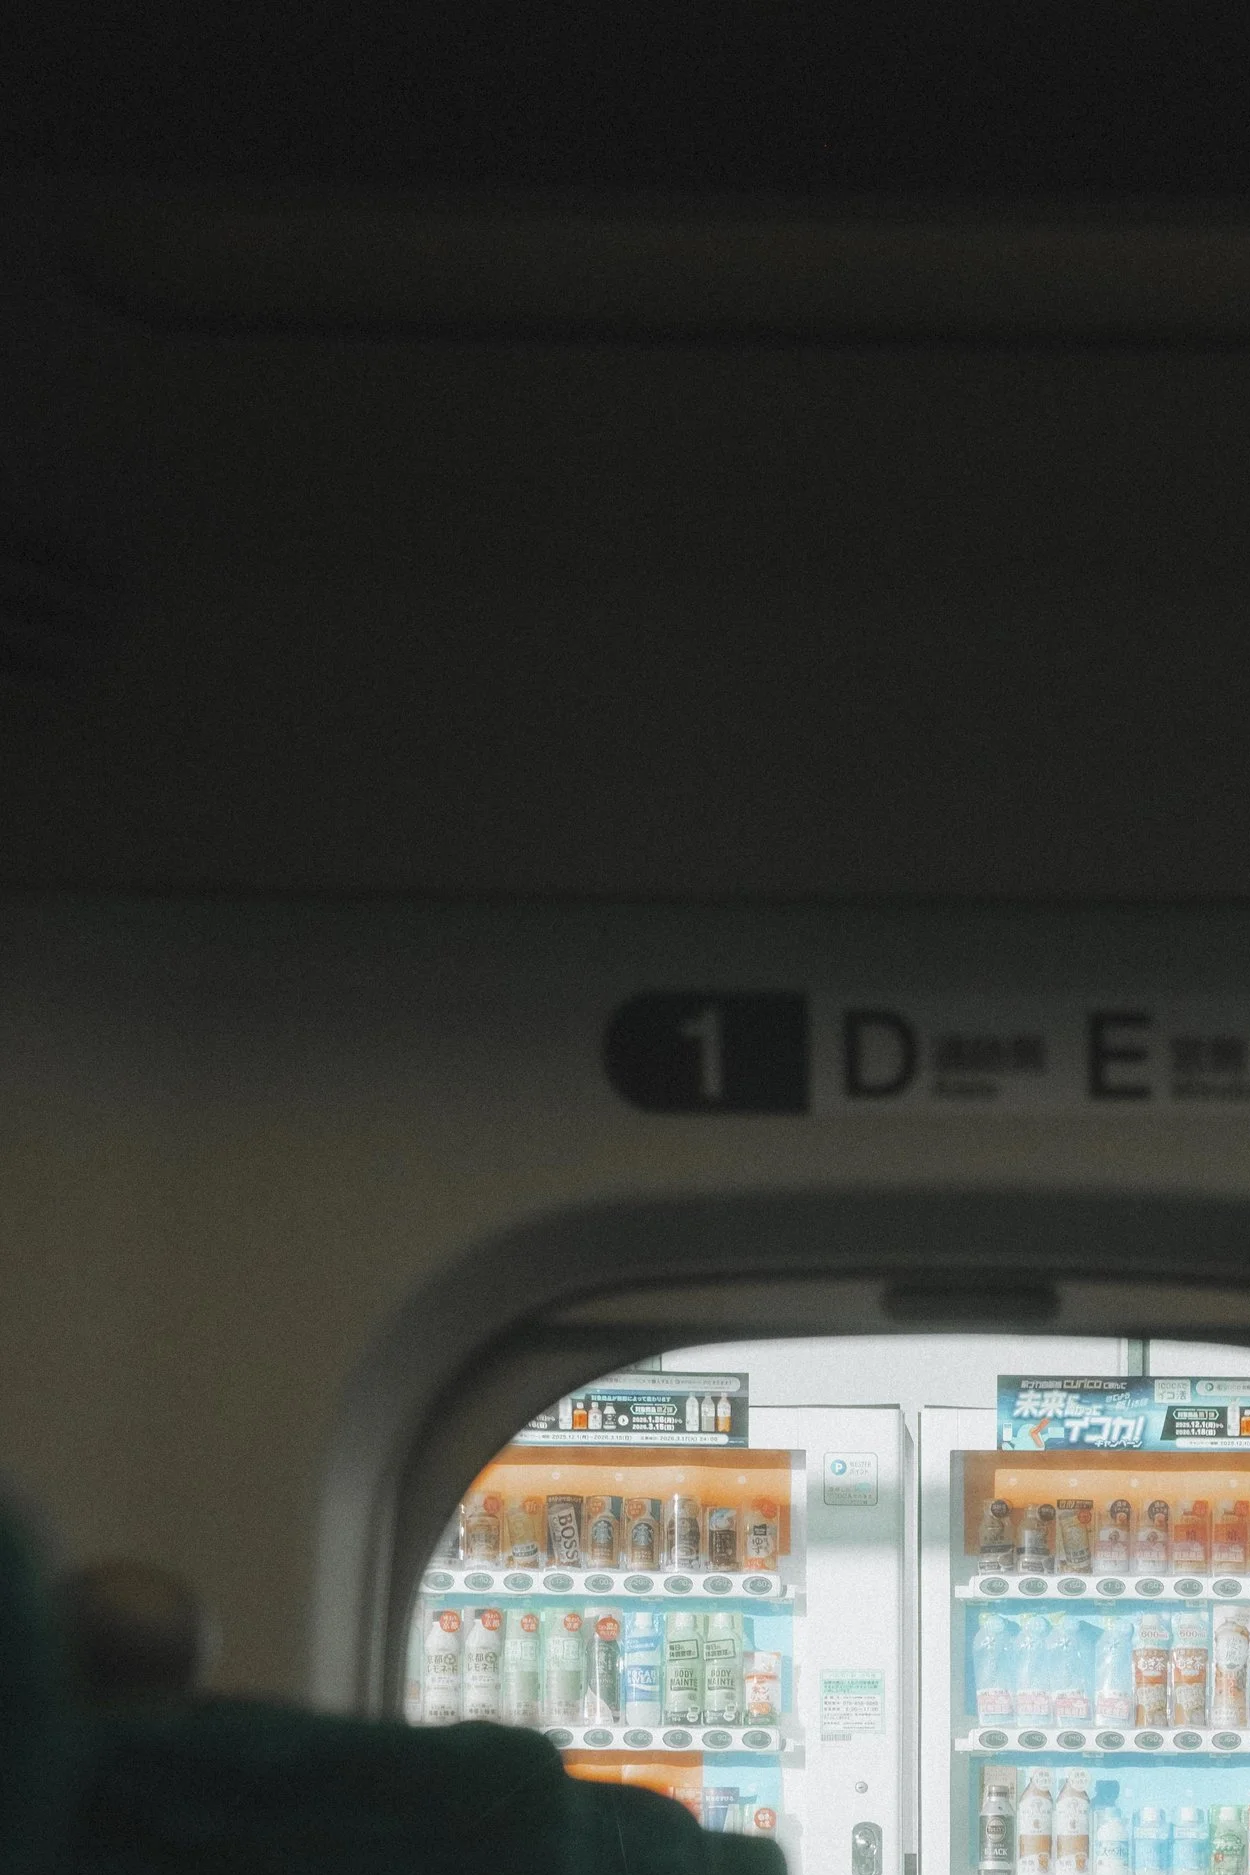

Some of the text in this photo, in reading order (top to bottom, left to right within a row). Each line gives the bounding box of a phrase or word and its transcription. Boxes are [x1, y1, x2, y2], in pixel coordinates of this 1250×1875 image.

[682, 1008, 722, 1100] 1
[842, 1009, 919, 1099] D
[1088, 1010, 1152, 1099] E
